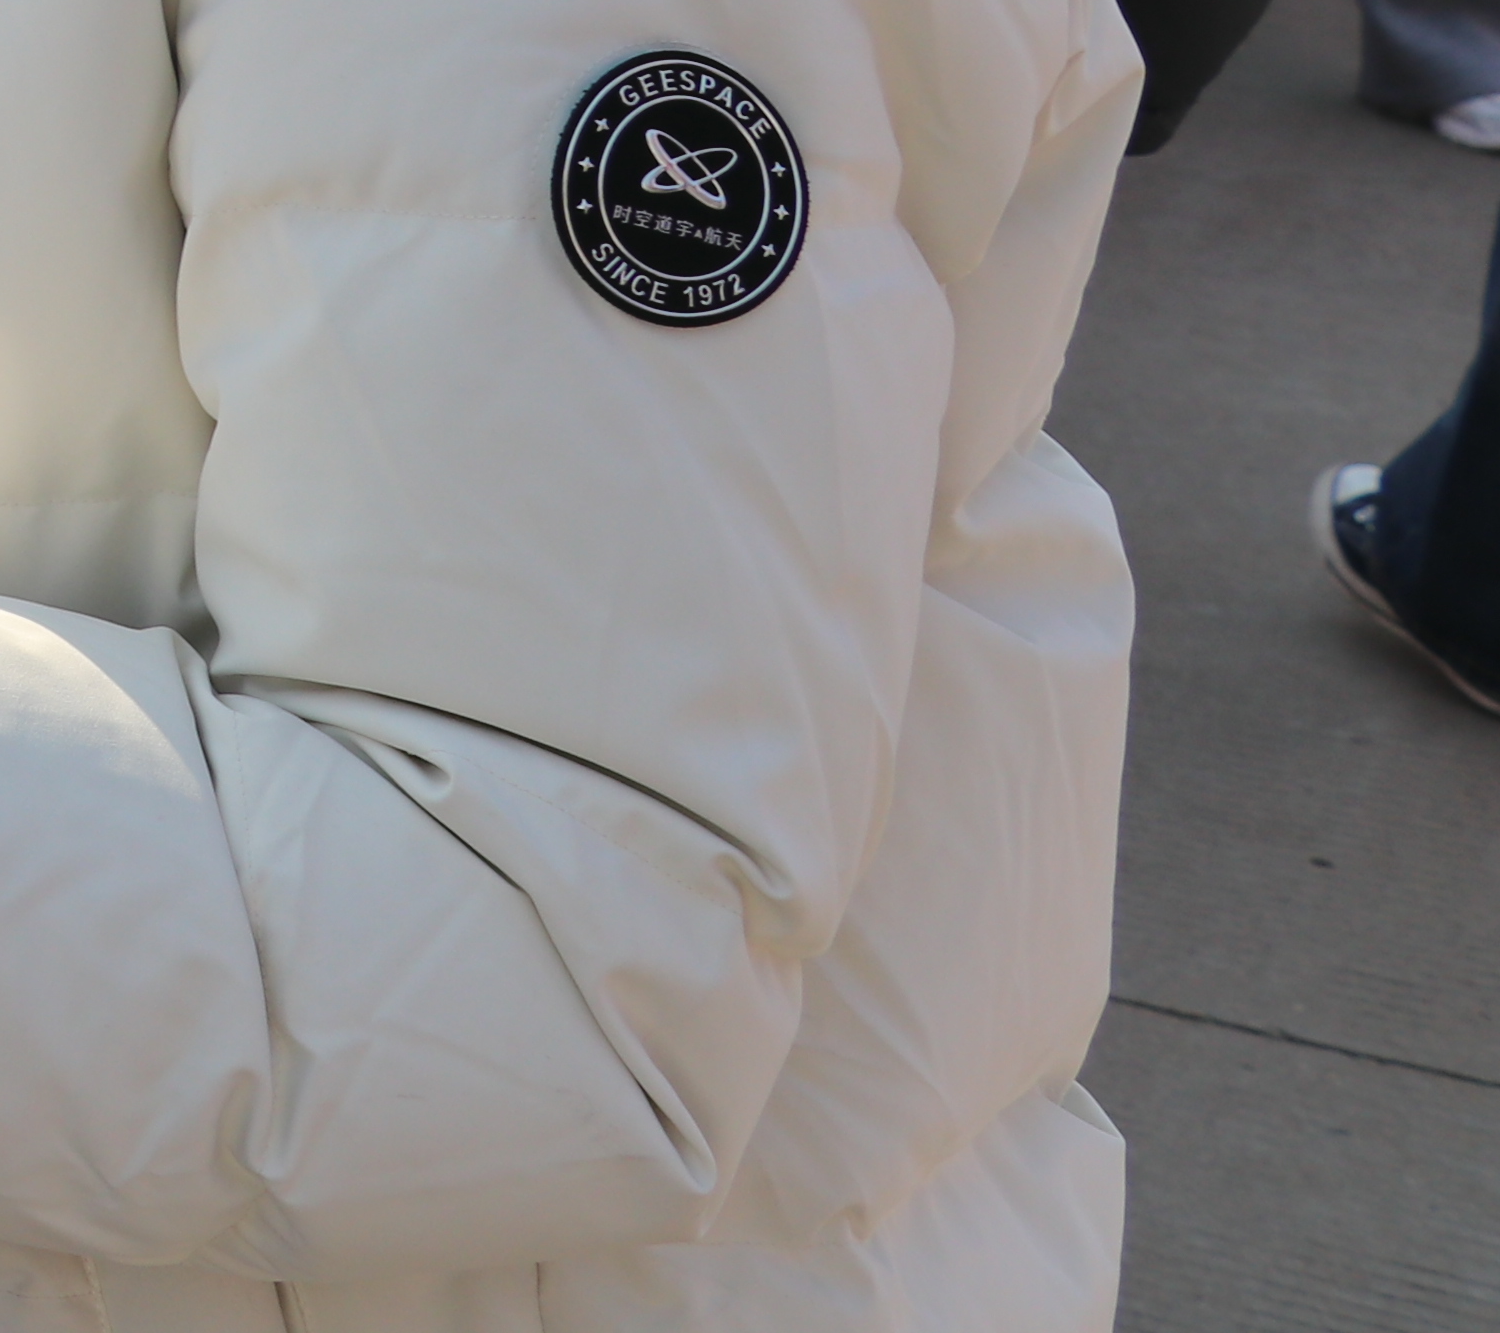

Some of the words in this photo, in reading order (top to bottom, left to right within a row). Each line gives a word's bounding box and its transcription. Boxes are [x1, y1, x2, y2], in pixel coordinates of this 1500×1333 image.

[619, 69, 771, 140] GEESPACE
[591, 242, 669, 305] SINCE
[683, 273, 747, 308] 1972
